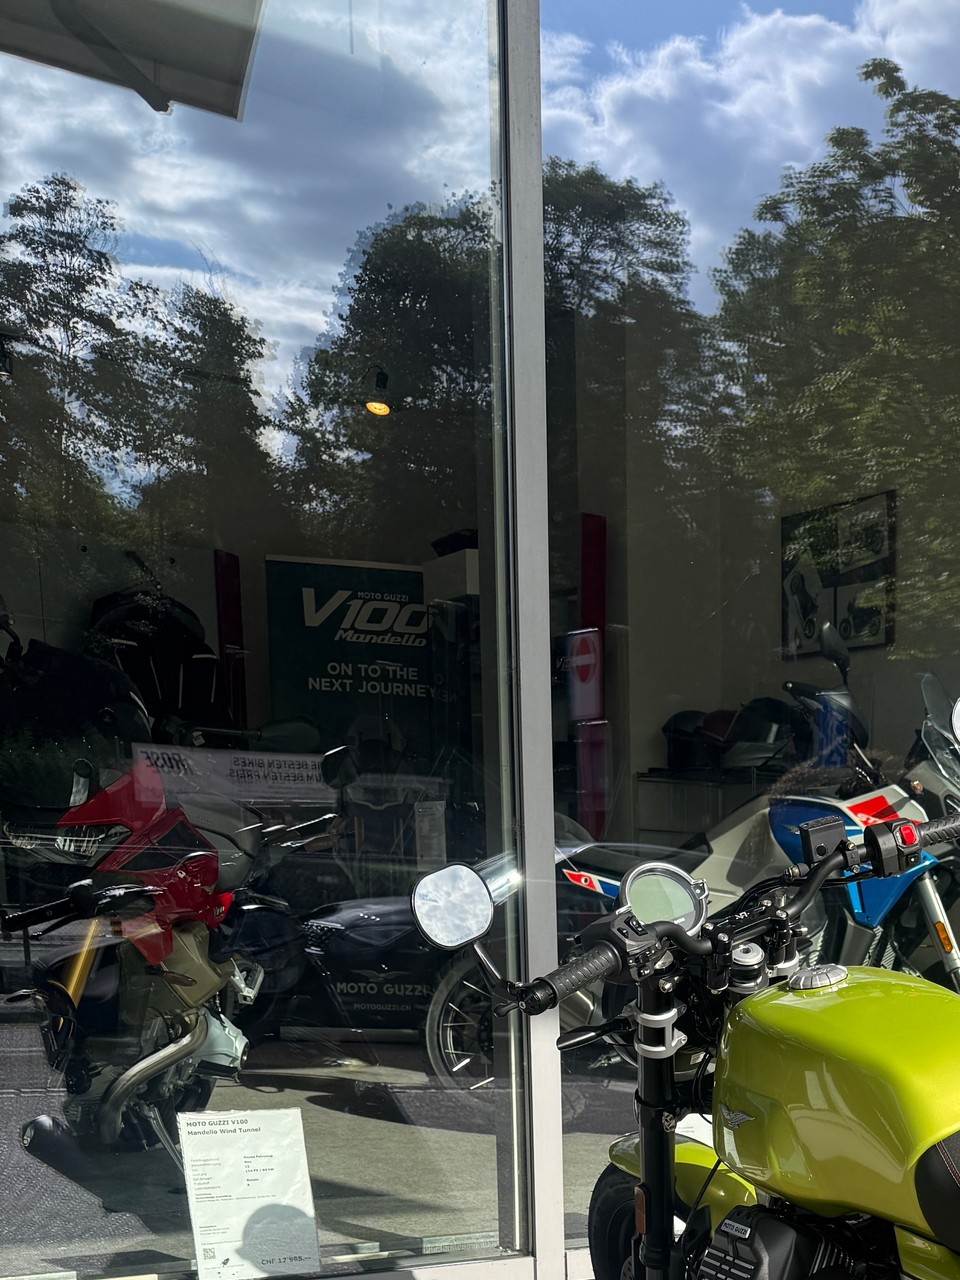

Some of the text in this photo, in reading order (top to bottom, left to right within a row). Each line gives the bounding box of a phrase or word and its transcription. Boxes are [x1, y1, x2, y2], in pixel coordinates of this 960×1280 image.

[357, 591, 409, 602] MOTO GUZZI
[302, 587, 428, 634] V100
[334, 629, 427, 647] Mandello
[327, 662, 418, 680] ON TO THE
[308, 677, 353, 692] NEXT
[336, 982, 428, 996] MOTO GUZZI
[353, 1003, 411, 1011] MOTOGUZZI.CH
[723, 1222, 748, 1235] MOTO GUZZI
